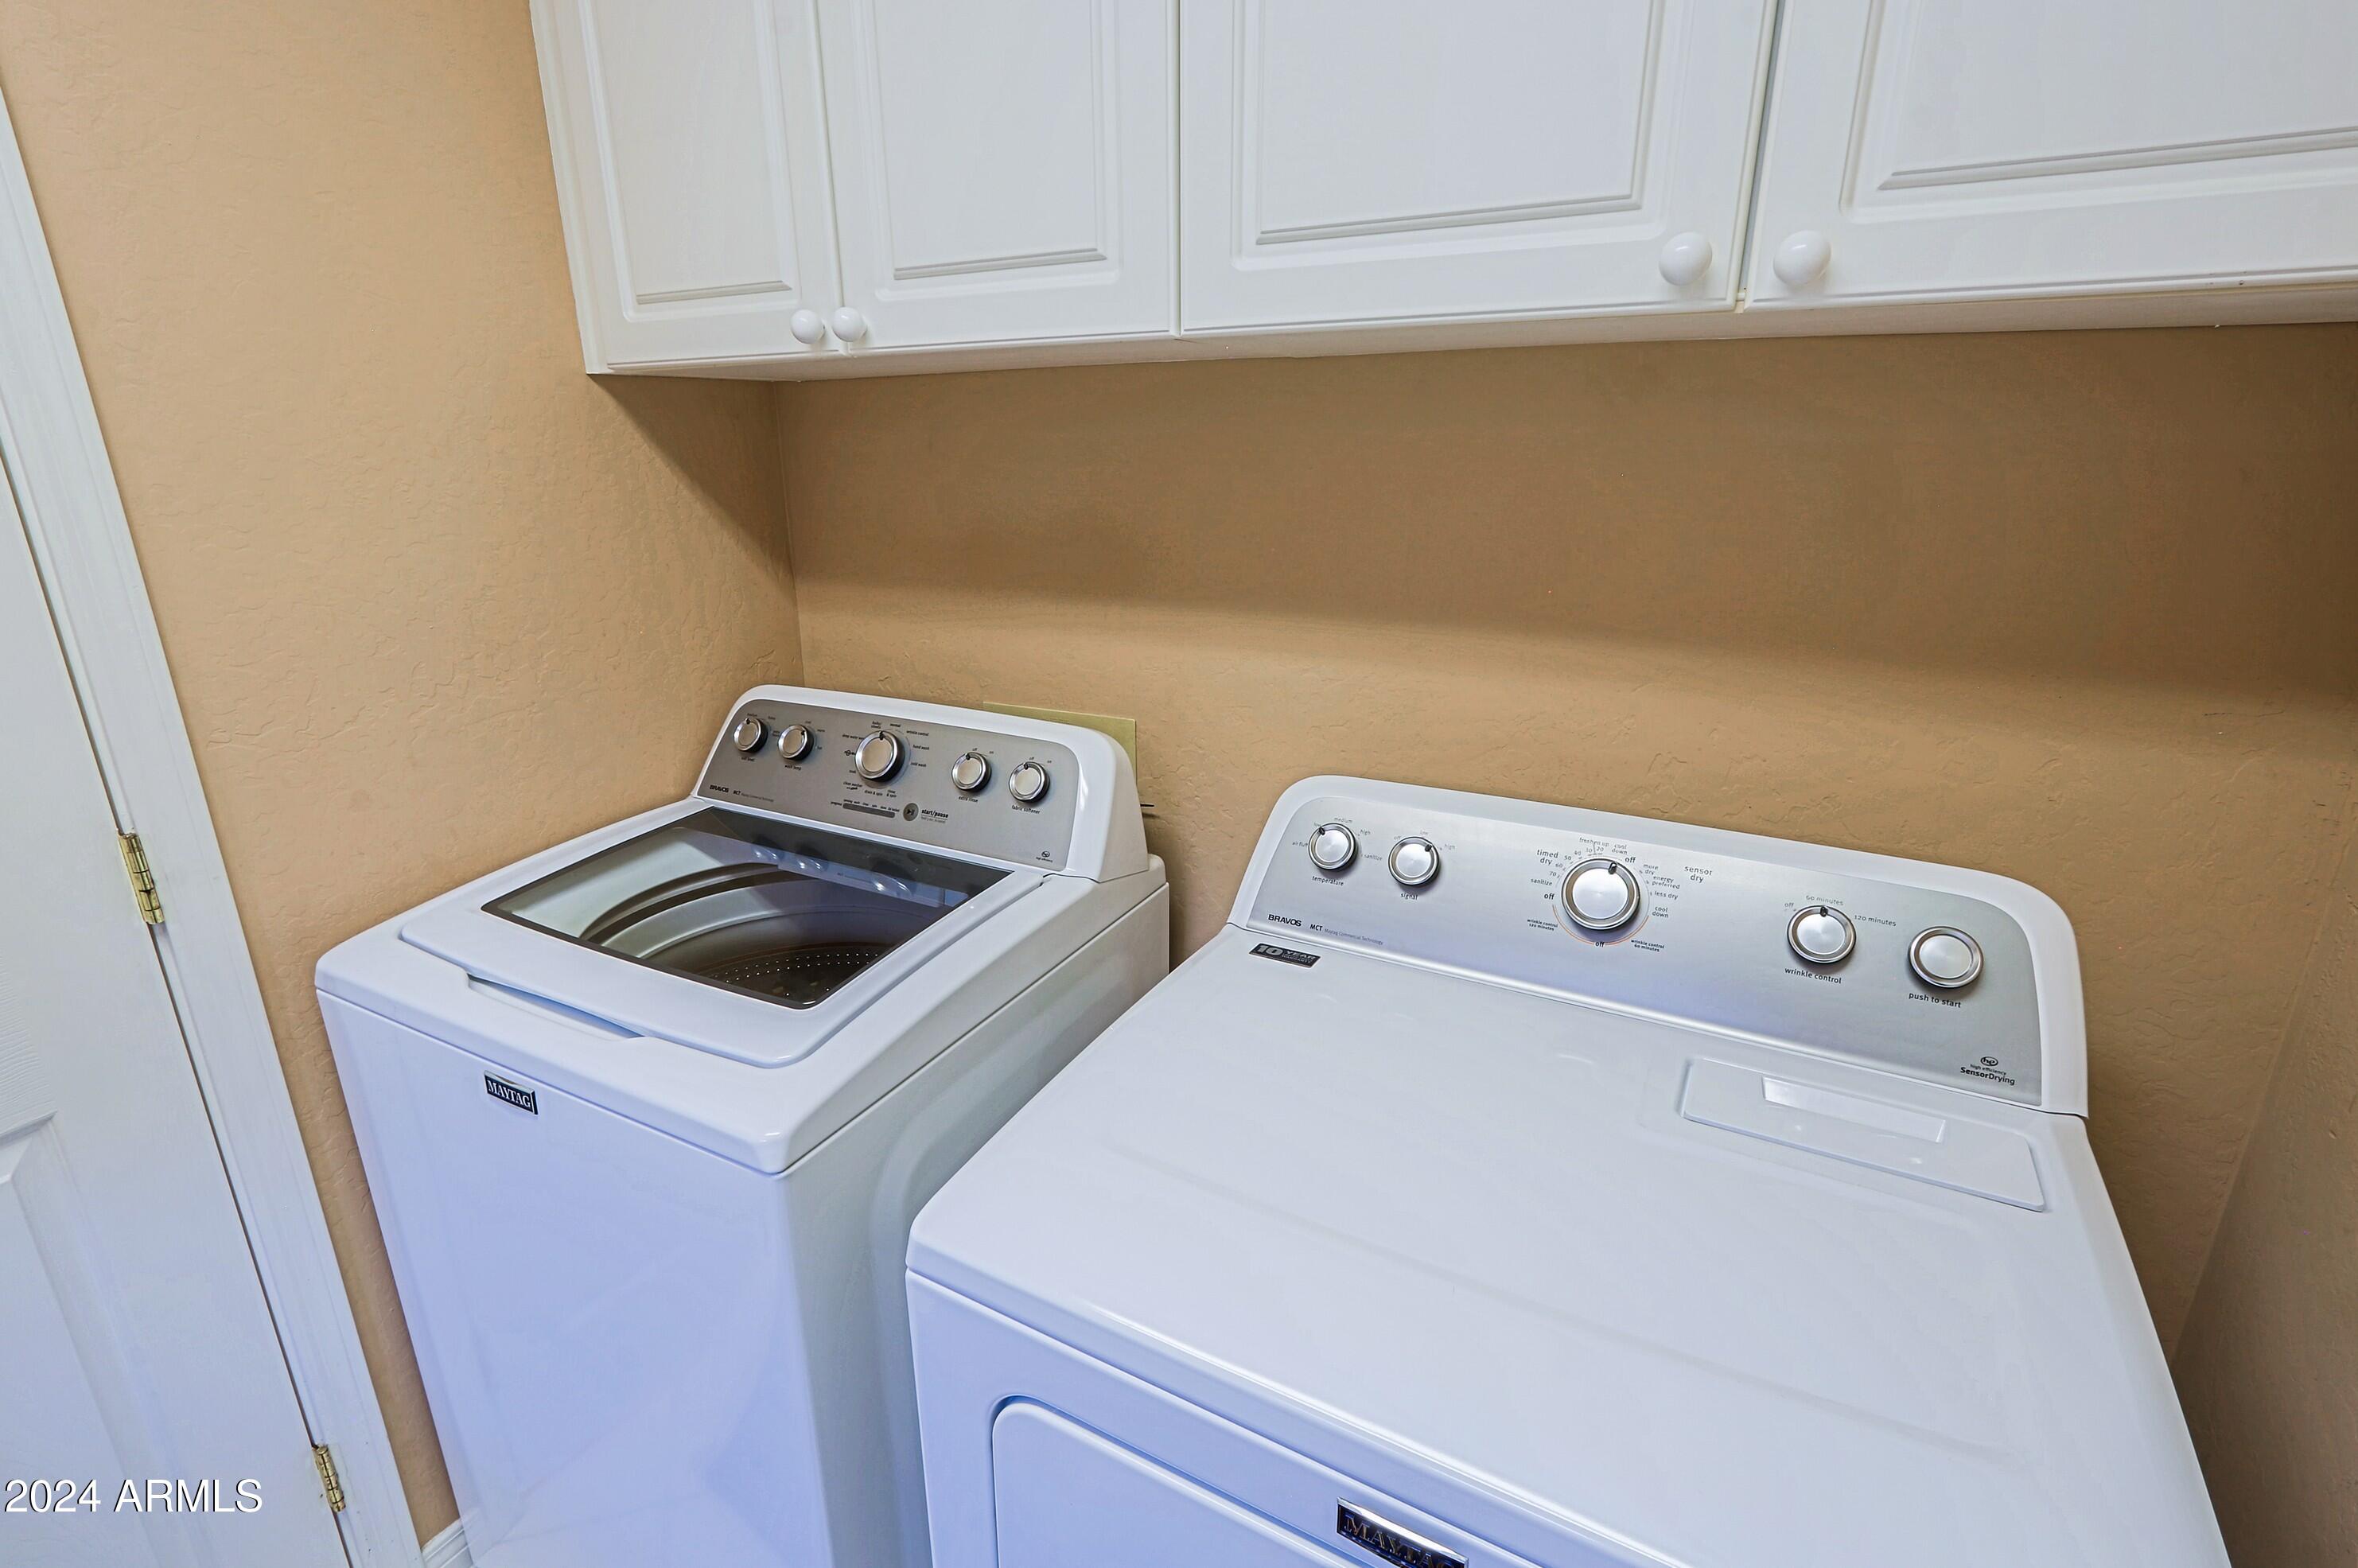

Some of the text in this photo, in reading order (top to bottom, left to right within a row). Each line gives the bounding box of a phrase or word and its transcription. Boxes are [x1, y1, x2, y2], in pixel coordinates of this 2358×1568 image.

[921, 809, 949, 818] start/pause
[1579, 837, 1601, 846] freshen
[1536, 849, 1559, 858] timed
[1539, 858, 1552, 866] dry
[1684, 866, 1713, 876] sensor
[1312, 875, 1344, 886] temperature
[1530, 877, 1553, 886] sanitize
[1690, 873, 1704, 883] dry
[1652, 881, 1680, 889] preferred
[1816, 897, 1844, 906] minutes
[1868, 917, 1897, 927] minutes
[1268, 914, 1302, 927] BRAVOS
[1361, 936, 1383, 945] Technology
[1257, 945, 1283, 955] 10
[1784, 967, 1842, 984] wrinkle control
[1909, 992, 1929, 1002] push
[1941, 998, 1961, 1008] start
[1960, 1067, 2015, 1086] SensorDrying
[1982, 1067, 2006, 1076] efficiency
[487, 1080, 531, 1107] MAYTAG
